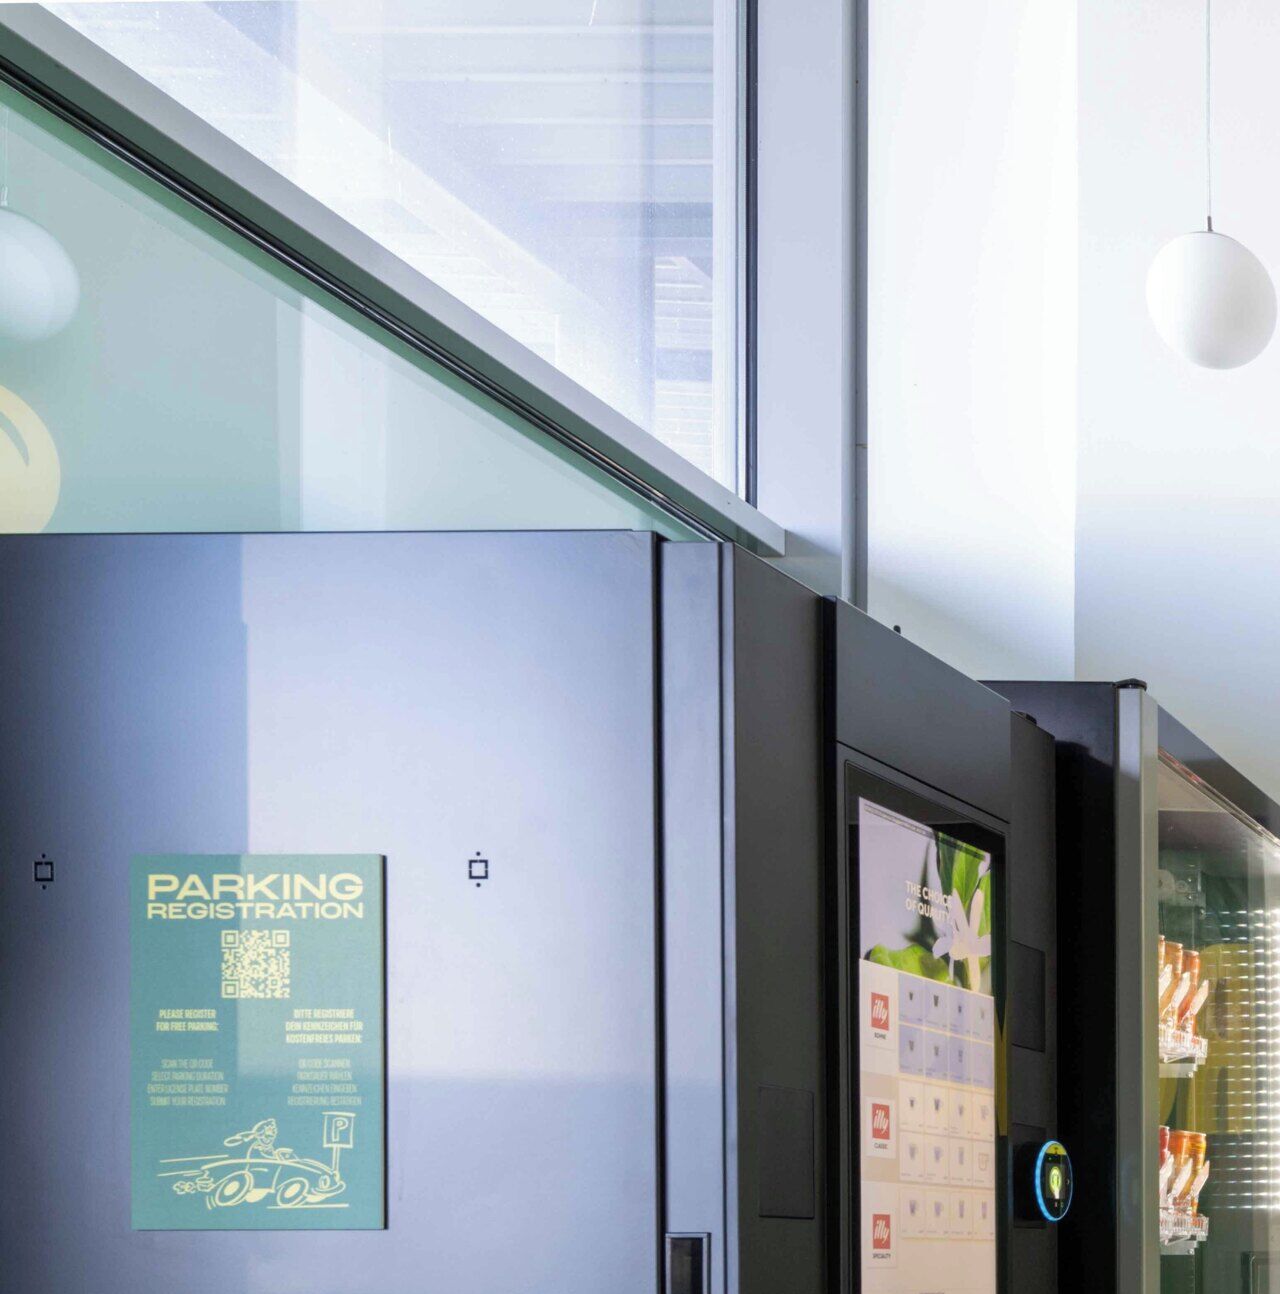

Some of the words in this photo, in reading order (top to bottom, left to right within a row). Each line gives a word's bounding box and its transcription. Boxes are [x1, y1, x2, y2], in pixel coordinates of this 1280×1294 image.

[147, 873, 363, 900] PARKING
[905, 880, 922, 897] THE
[147, 902, 363, 919] REGISTRATION
[905, 898, 915, 911] OF
[159, 1009, 184, 1019] PLEASE
[185, 1009, 216, 1019] REGISTER
[156, 1021, 170, 1031] FOR
[171, 1021, 186, 1031] FREE
